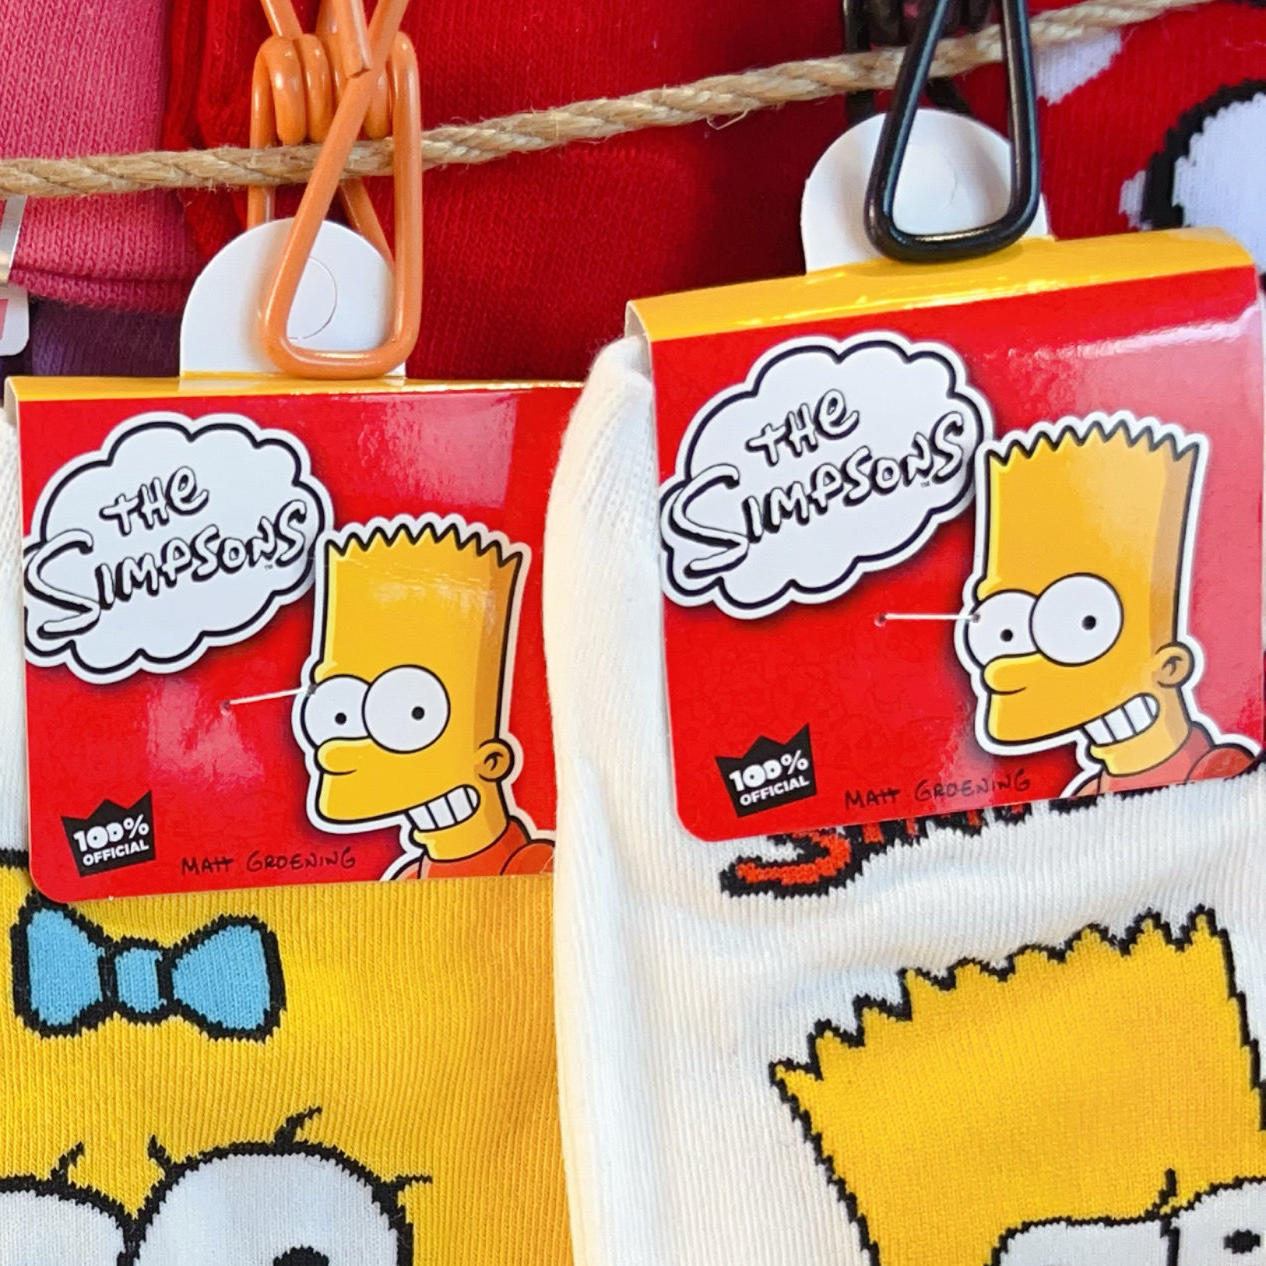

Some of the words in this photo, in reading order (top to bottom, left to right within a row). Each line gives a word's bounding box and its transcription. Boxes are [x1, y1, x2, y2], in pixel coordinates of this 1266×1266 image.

[728, 749, 808, 792] 100%
[740, 775, 810, 806] OFFICIAL
[74, 814, 150, 852] 100%
[83, 839, 149, 867] OFFICIAL
